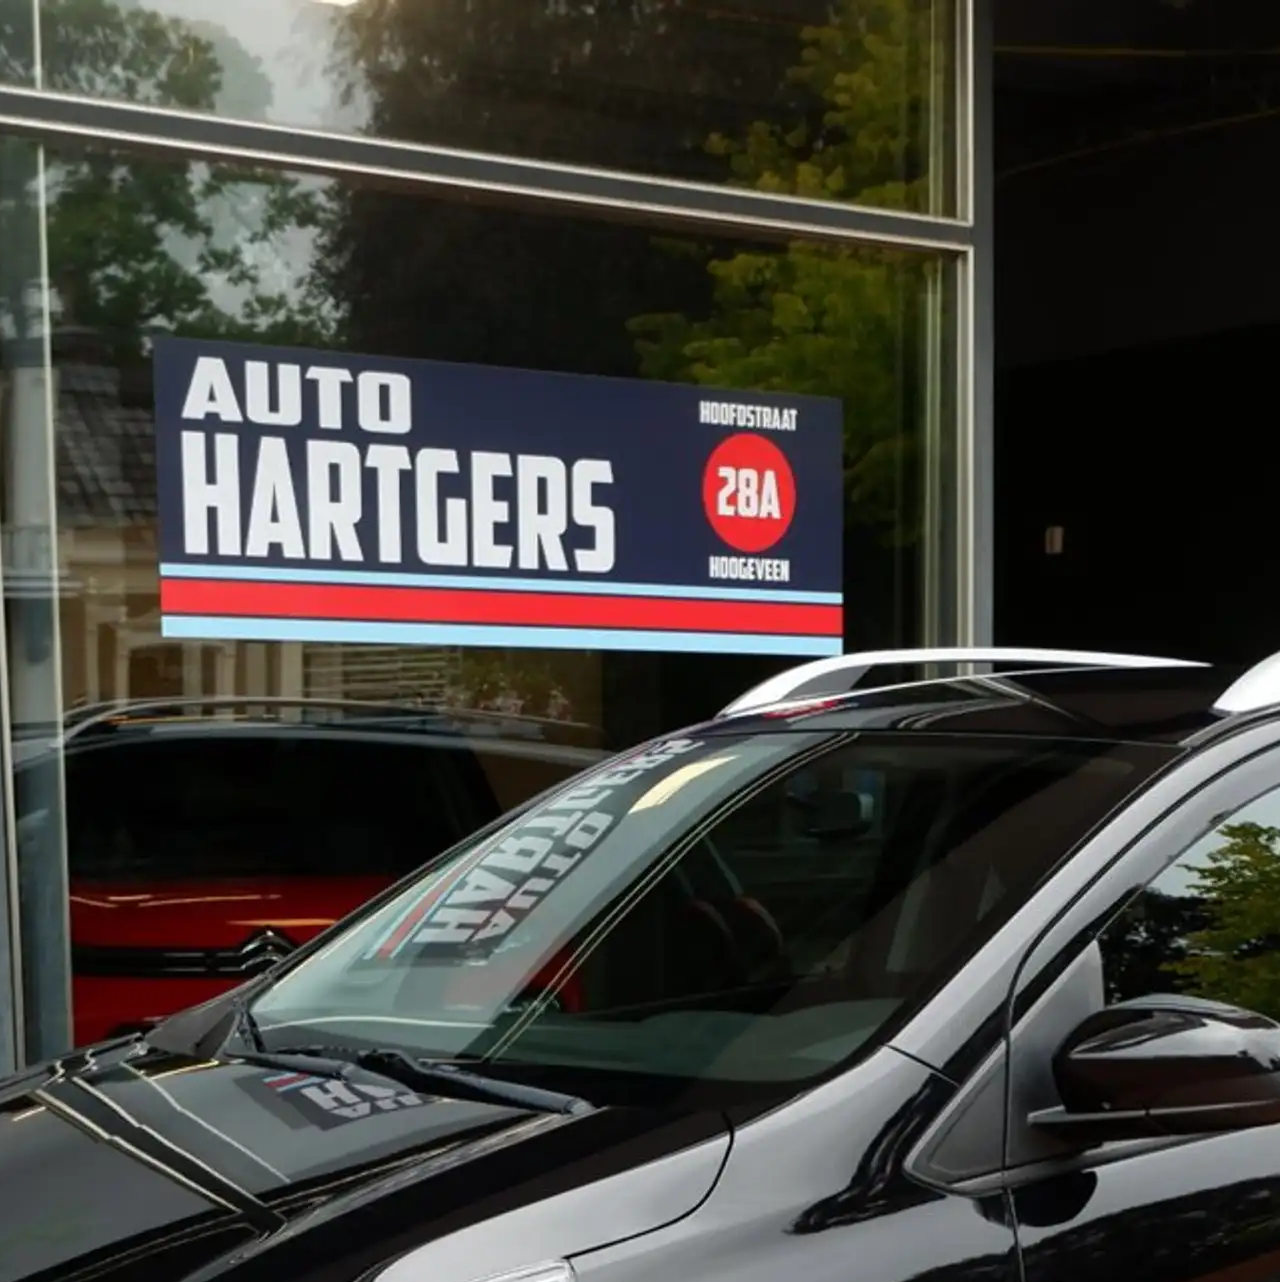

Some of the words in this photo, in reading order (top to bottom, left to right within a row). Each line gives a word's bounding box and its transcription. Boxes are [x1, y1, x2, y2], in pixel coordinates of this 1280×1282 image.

[180, 356, 412, 434] AUTO
[698, 400, 799, 432] HOOFDSTRAAT
[180, 430, 616, 574] HARTGERS
[716, 465, 781, 520] 28A
[708, 554, 791, 583] HOOGEVEEN
